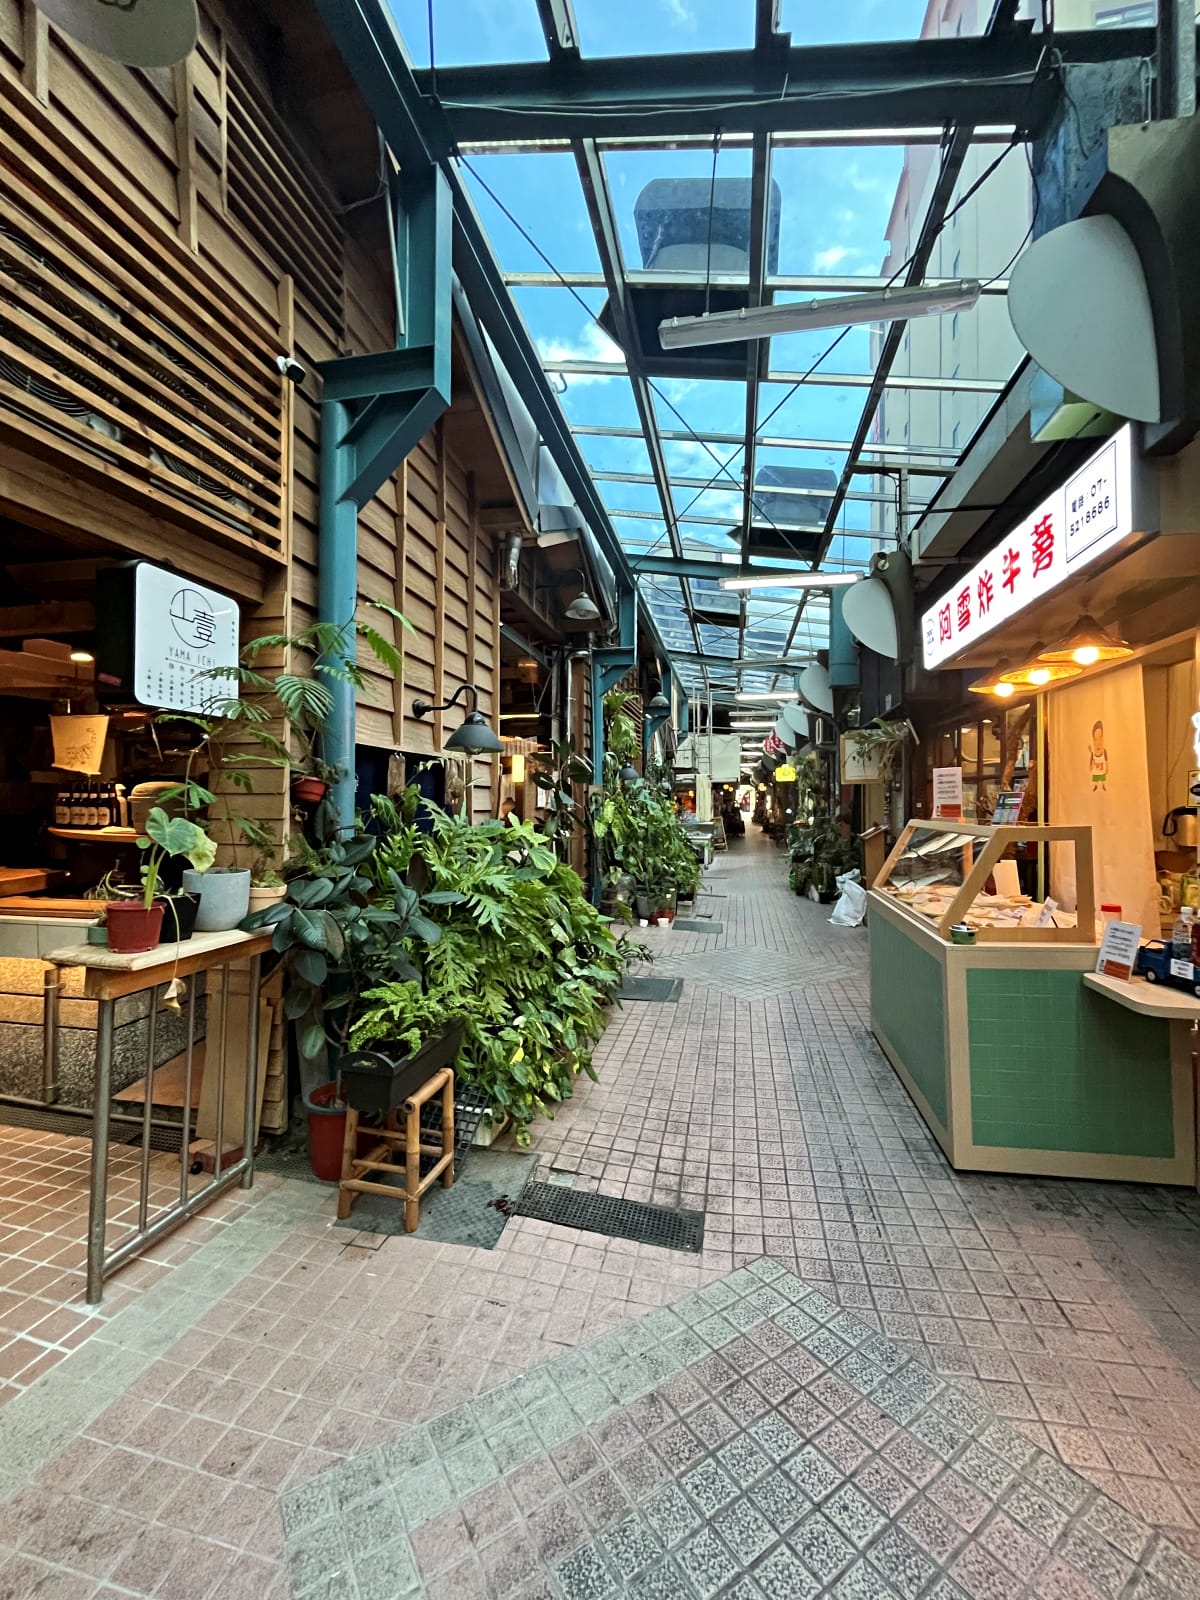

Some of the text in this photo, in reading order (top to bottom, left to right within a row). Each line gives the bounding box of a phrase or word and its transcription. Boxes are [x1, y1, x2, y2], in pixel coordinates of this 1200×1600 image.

[1070, 495, 1110, 537] 5218686
[938, 513, 1055, 645] 阿雪炸牛蒡
[168, 646, 216, 667] YAMA ICHI
